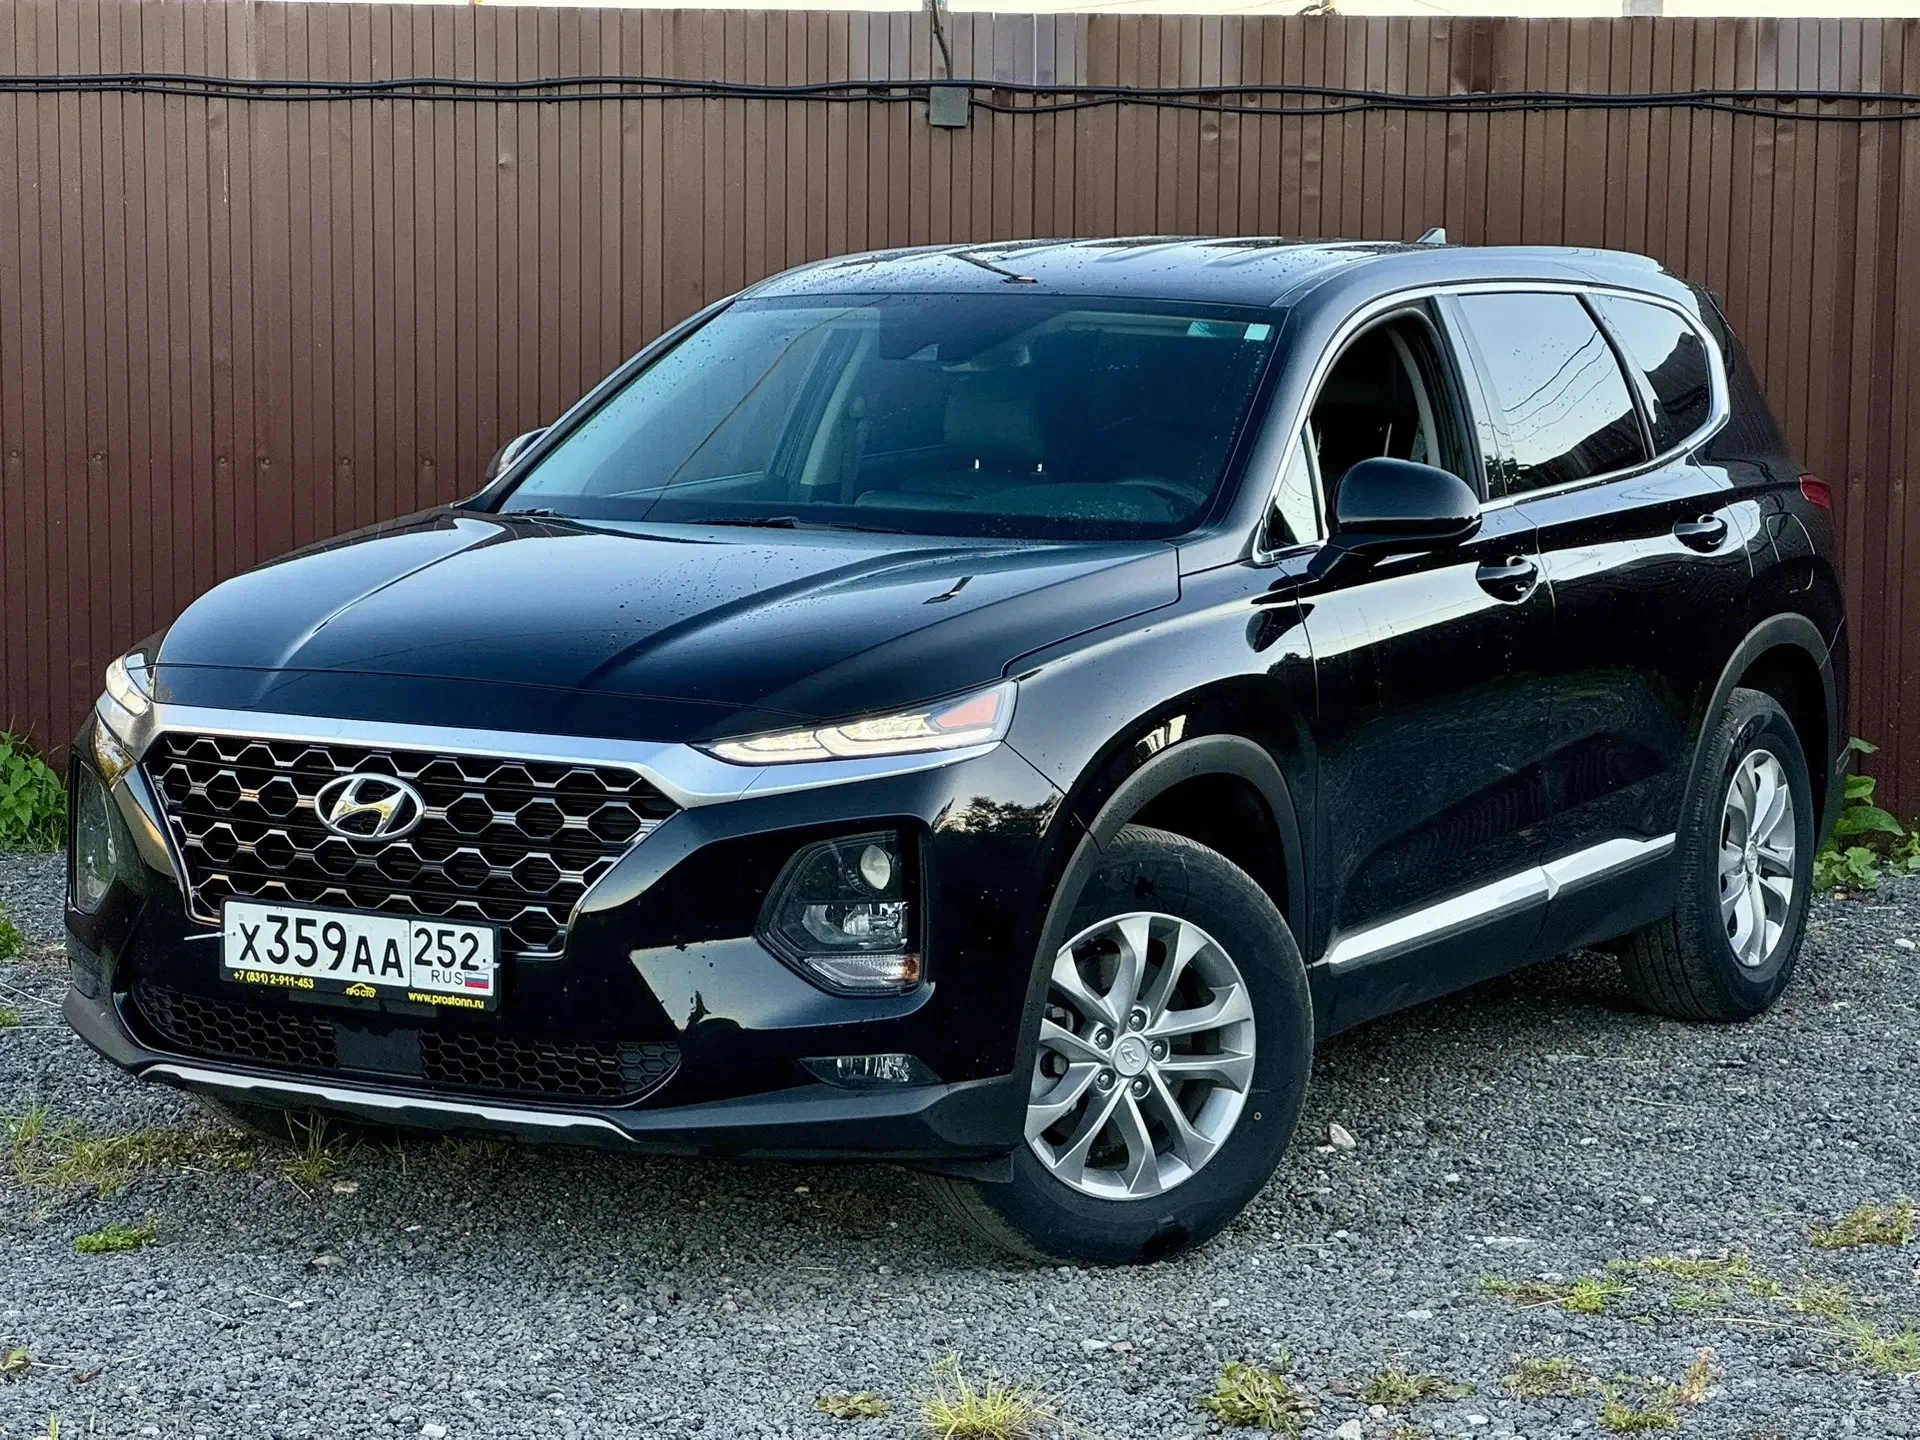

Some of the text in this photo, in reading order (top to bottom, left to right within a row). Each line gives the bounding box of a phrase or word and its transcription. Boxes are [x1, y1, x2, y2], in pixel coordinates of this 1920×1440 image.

[414, 927, 479, 972] 252
[233, 970, 314, 989] +7 (831) 2-911-453
[431, 969, 463, 985] RUS
[408, 991, 485, 1010] www.prostonn.ru
